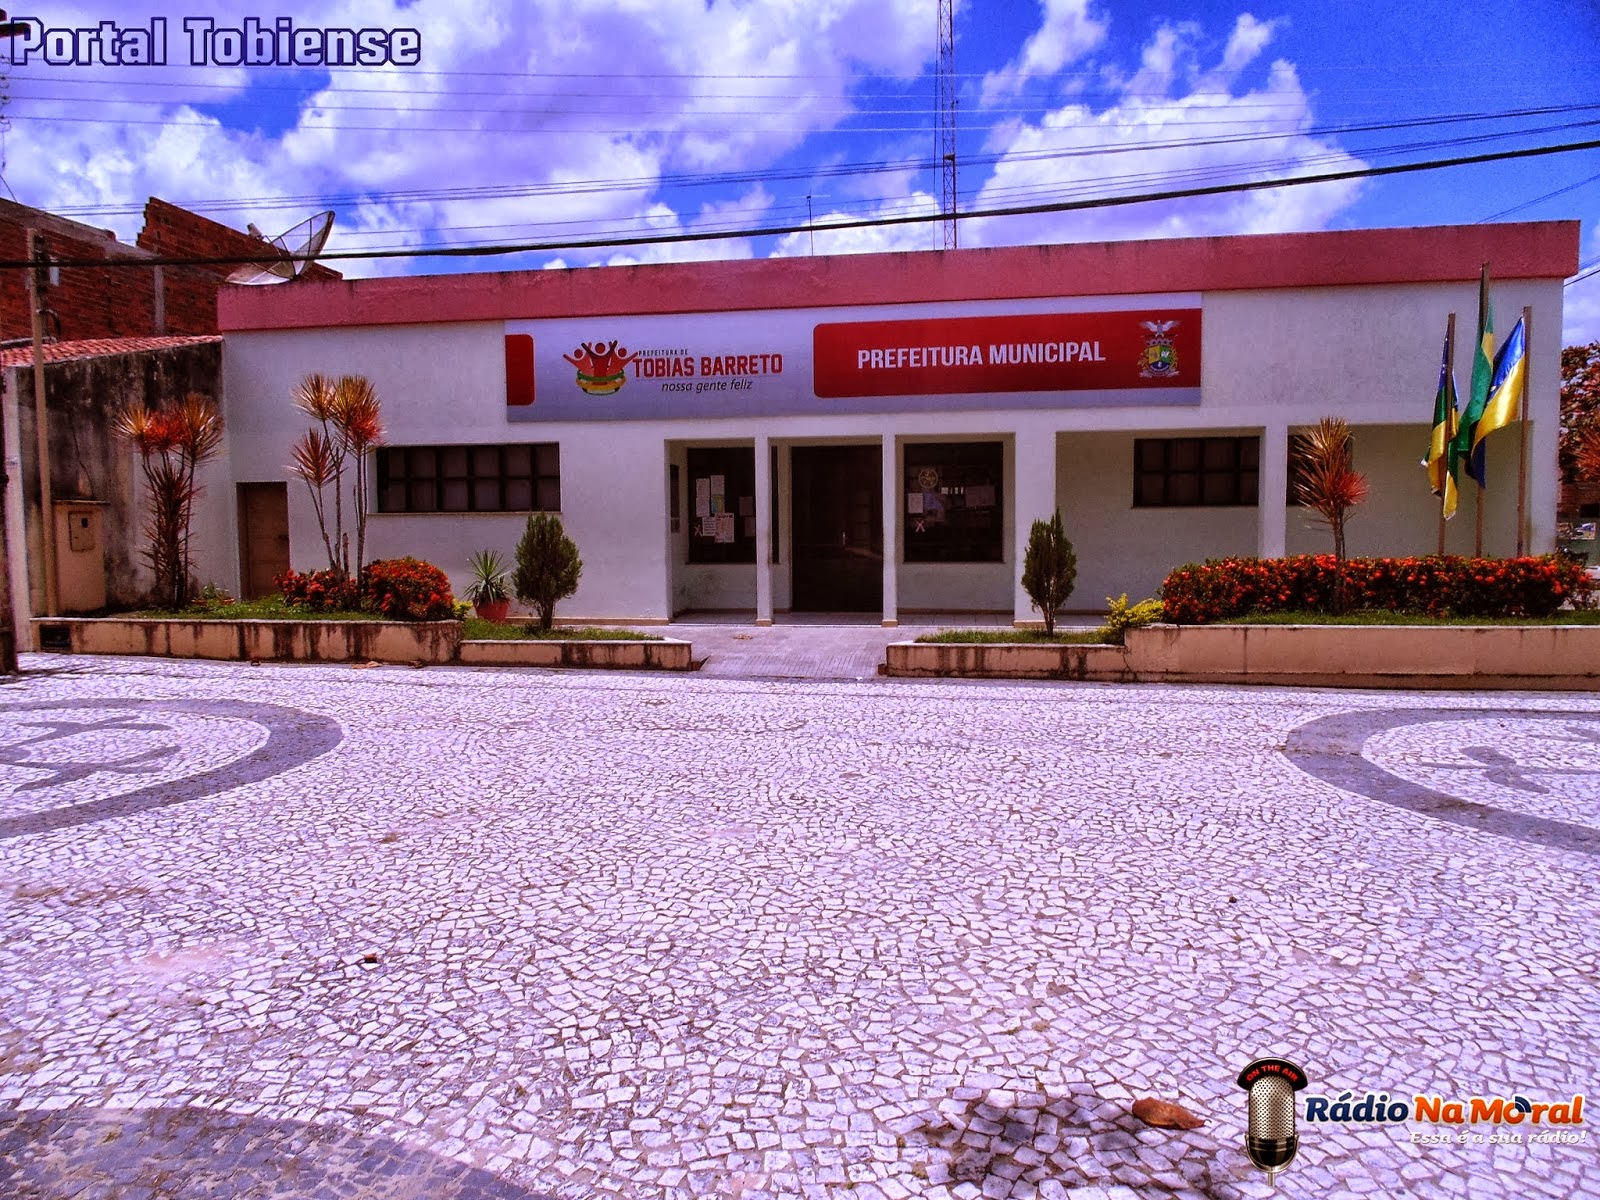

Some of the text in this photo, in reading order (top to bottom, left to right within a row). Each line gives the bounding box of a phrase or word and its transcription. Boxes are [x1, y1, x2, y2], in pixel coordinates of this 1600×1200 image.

[680, 348, 688, 356] DE
[857, 341, 1106, 369] PREFEITURA MUNICIPAL
[632, 354, 783, 378] TOBIAS BARRETO
[661, 379, 753, 394] nossa gente feliz
